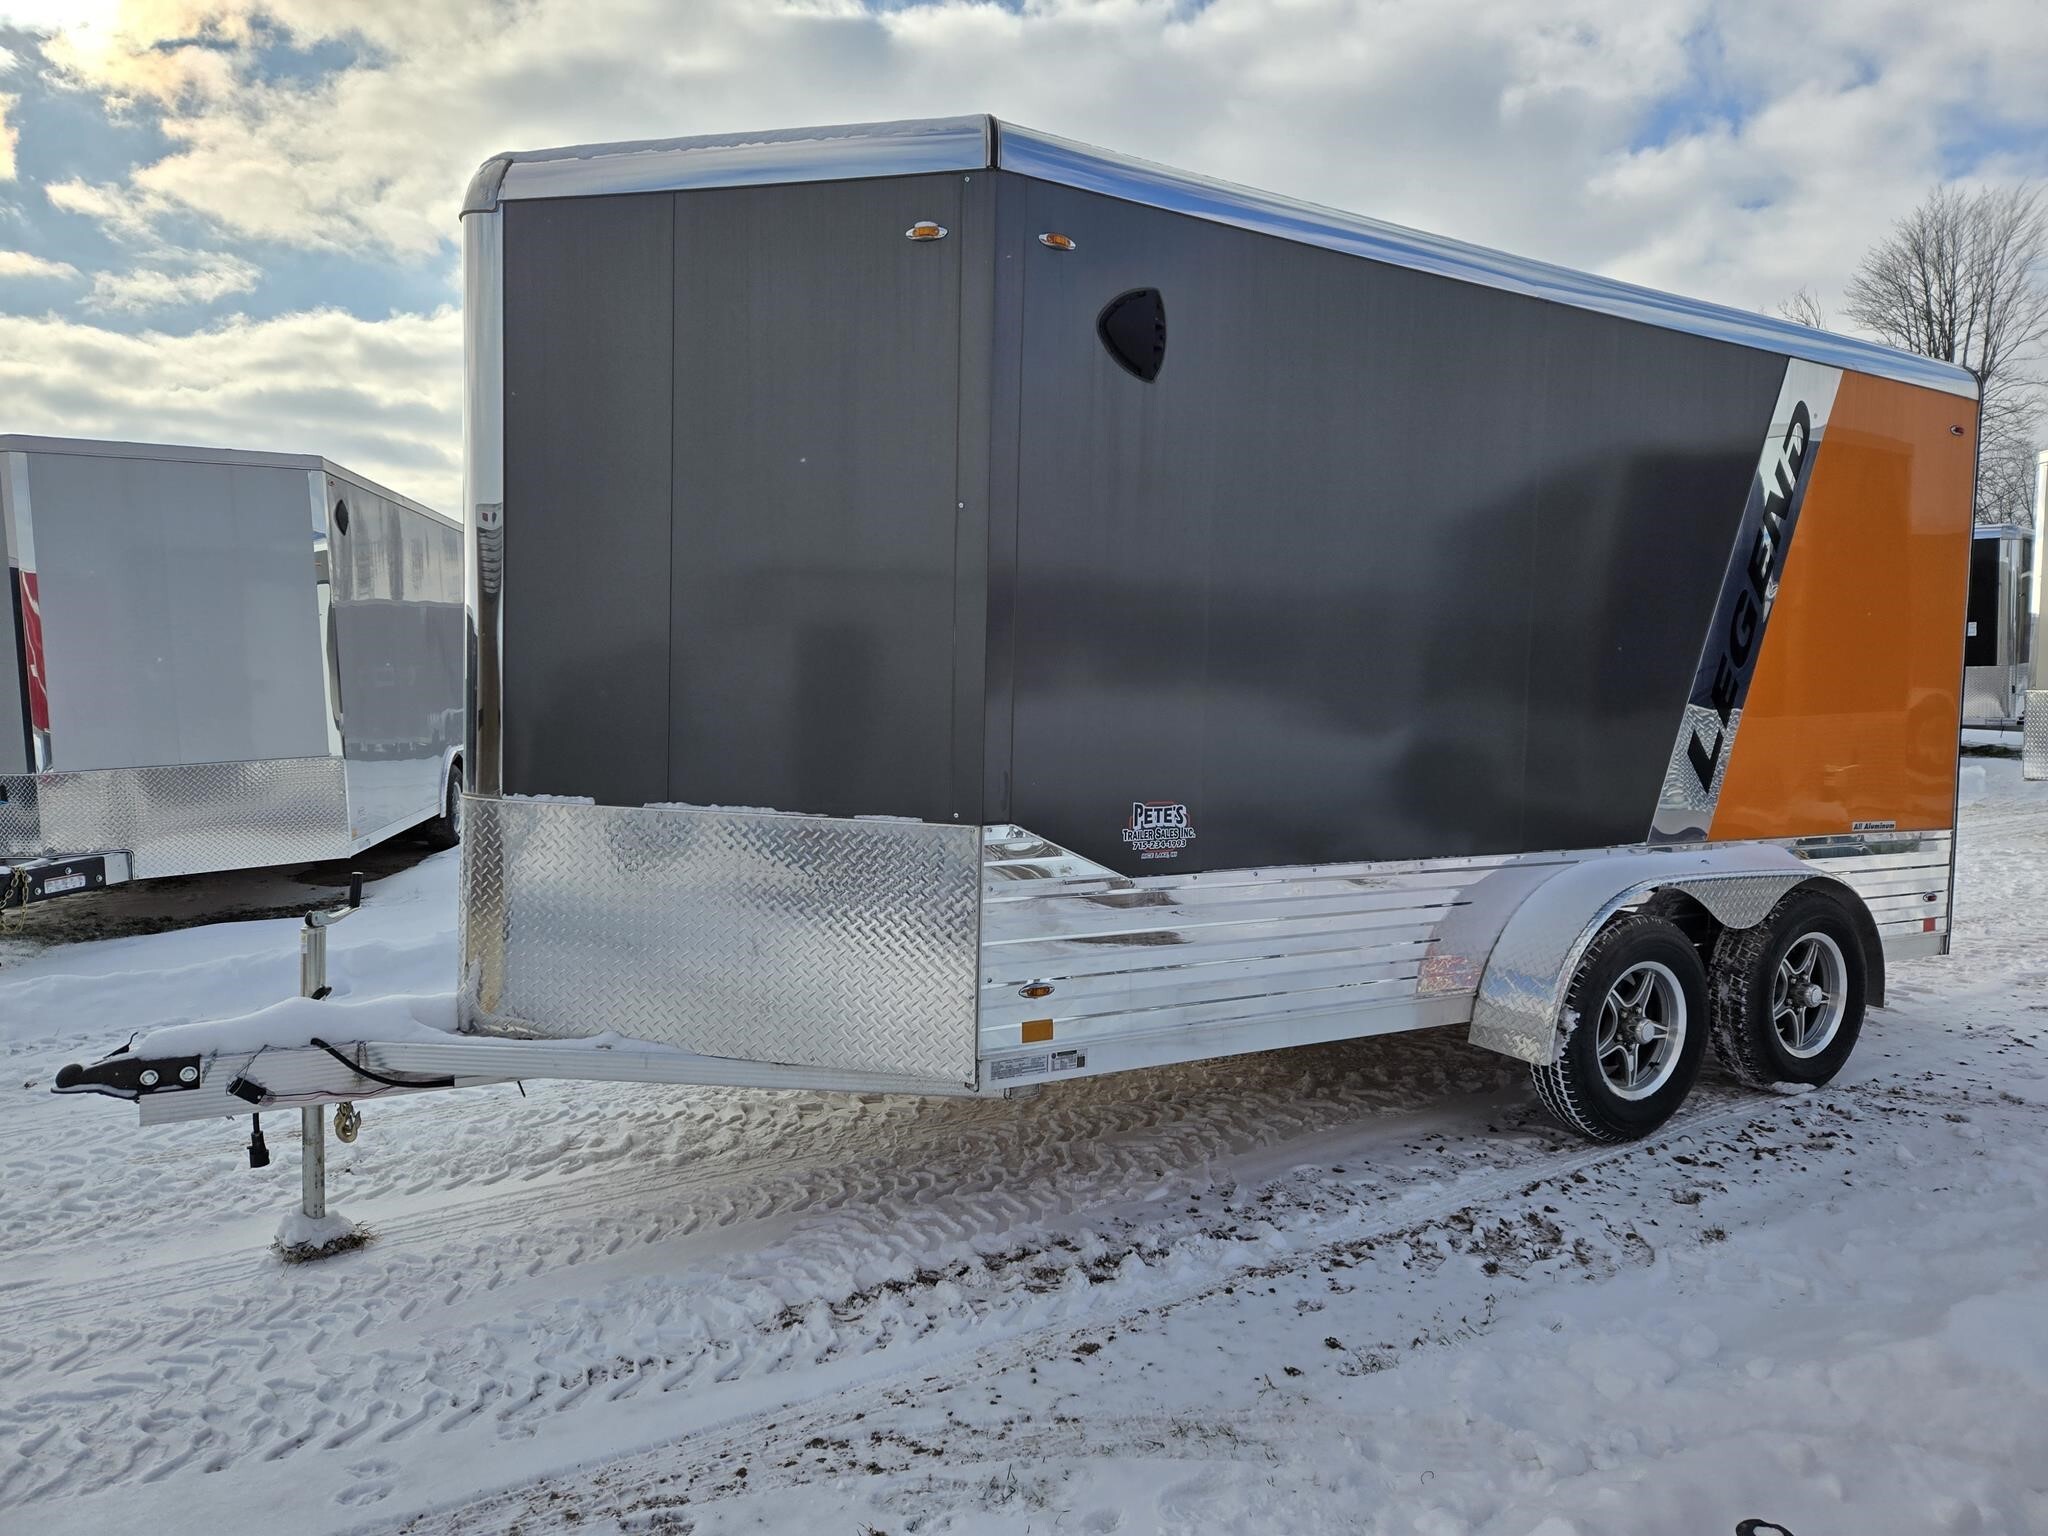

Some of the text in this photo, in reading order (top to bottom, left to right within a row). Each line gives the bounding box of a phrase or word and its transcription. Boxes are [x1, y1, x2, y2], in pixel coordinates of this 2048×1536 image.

[1687, 400, 1810, 794] LEGEND
[1133, 802, 1186, 828] PETE'S
[1123, 829, 1154, 841] TRAILER
[1155, 828, 1179, 840] SALES
